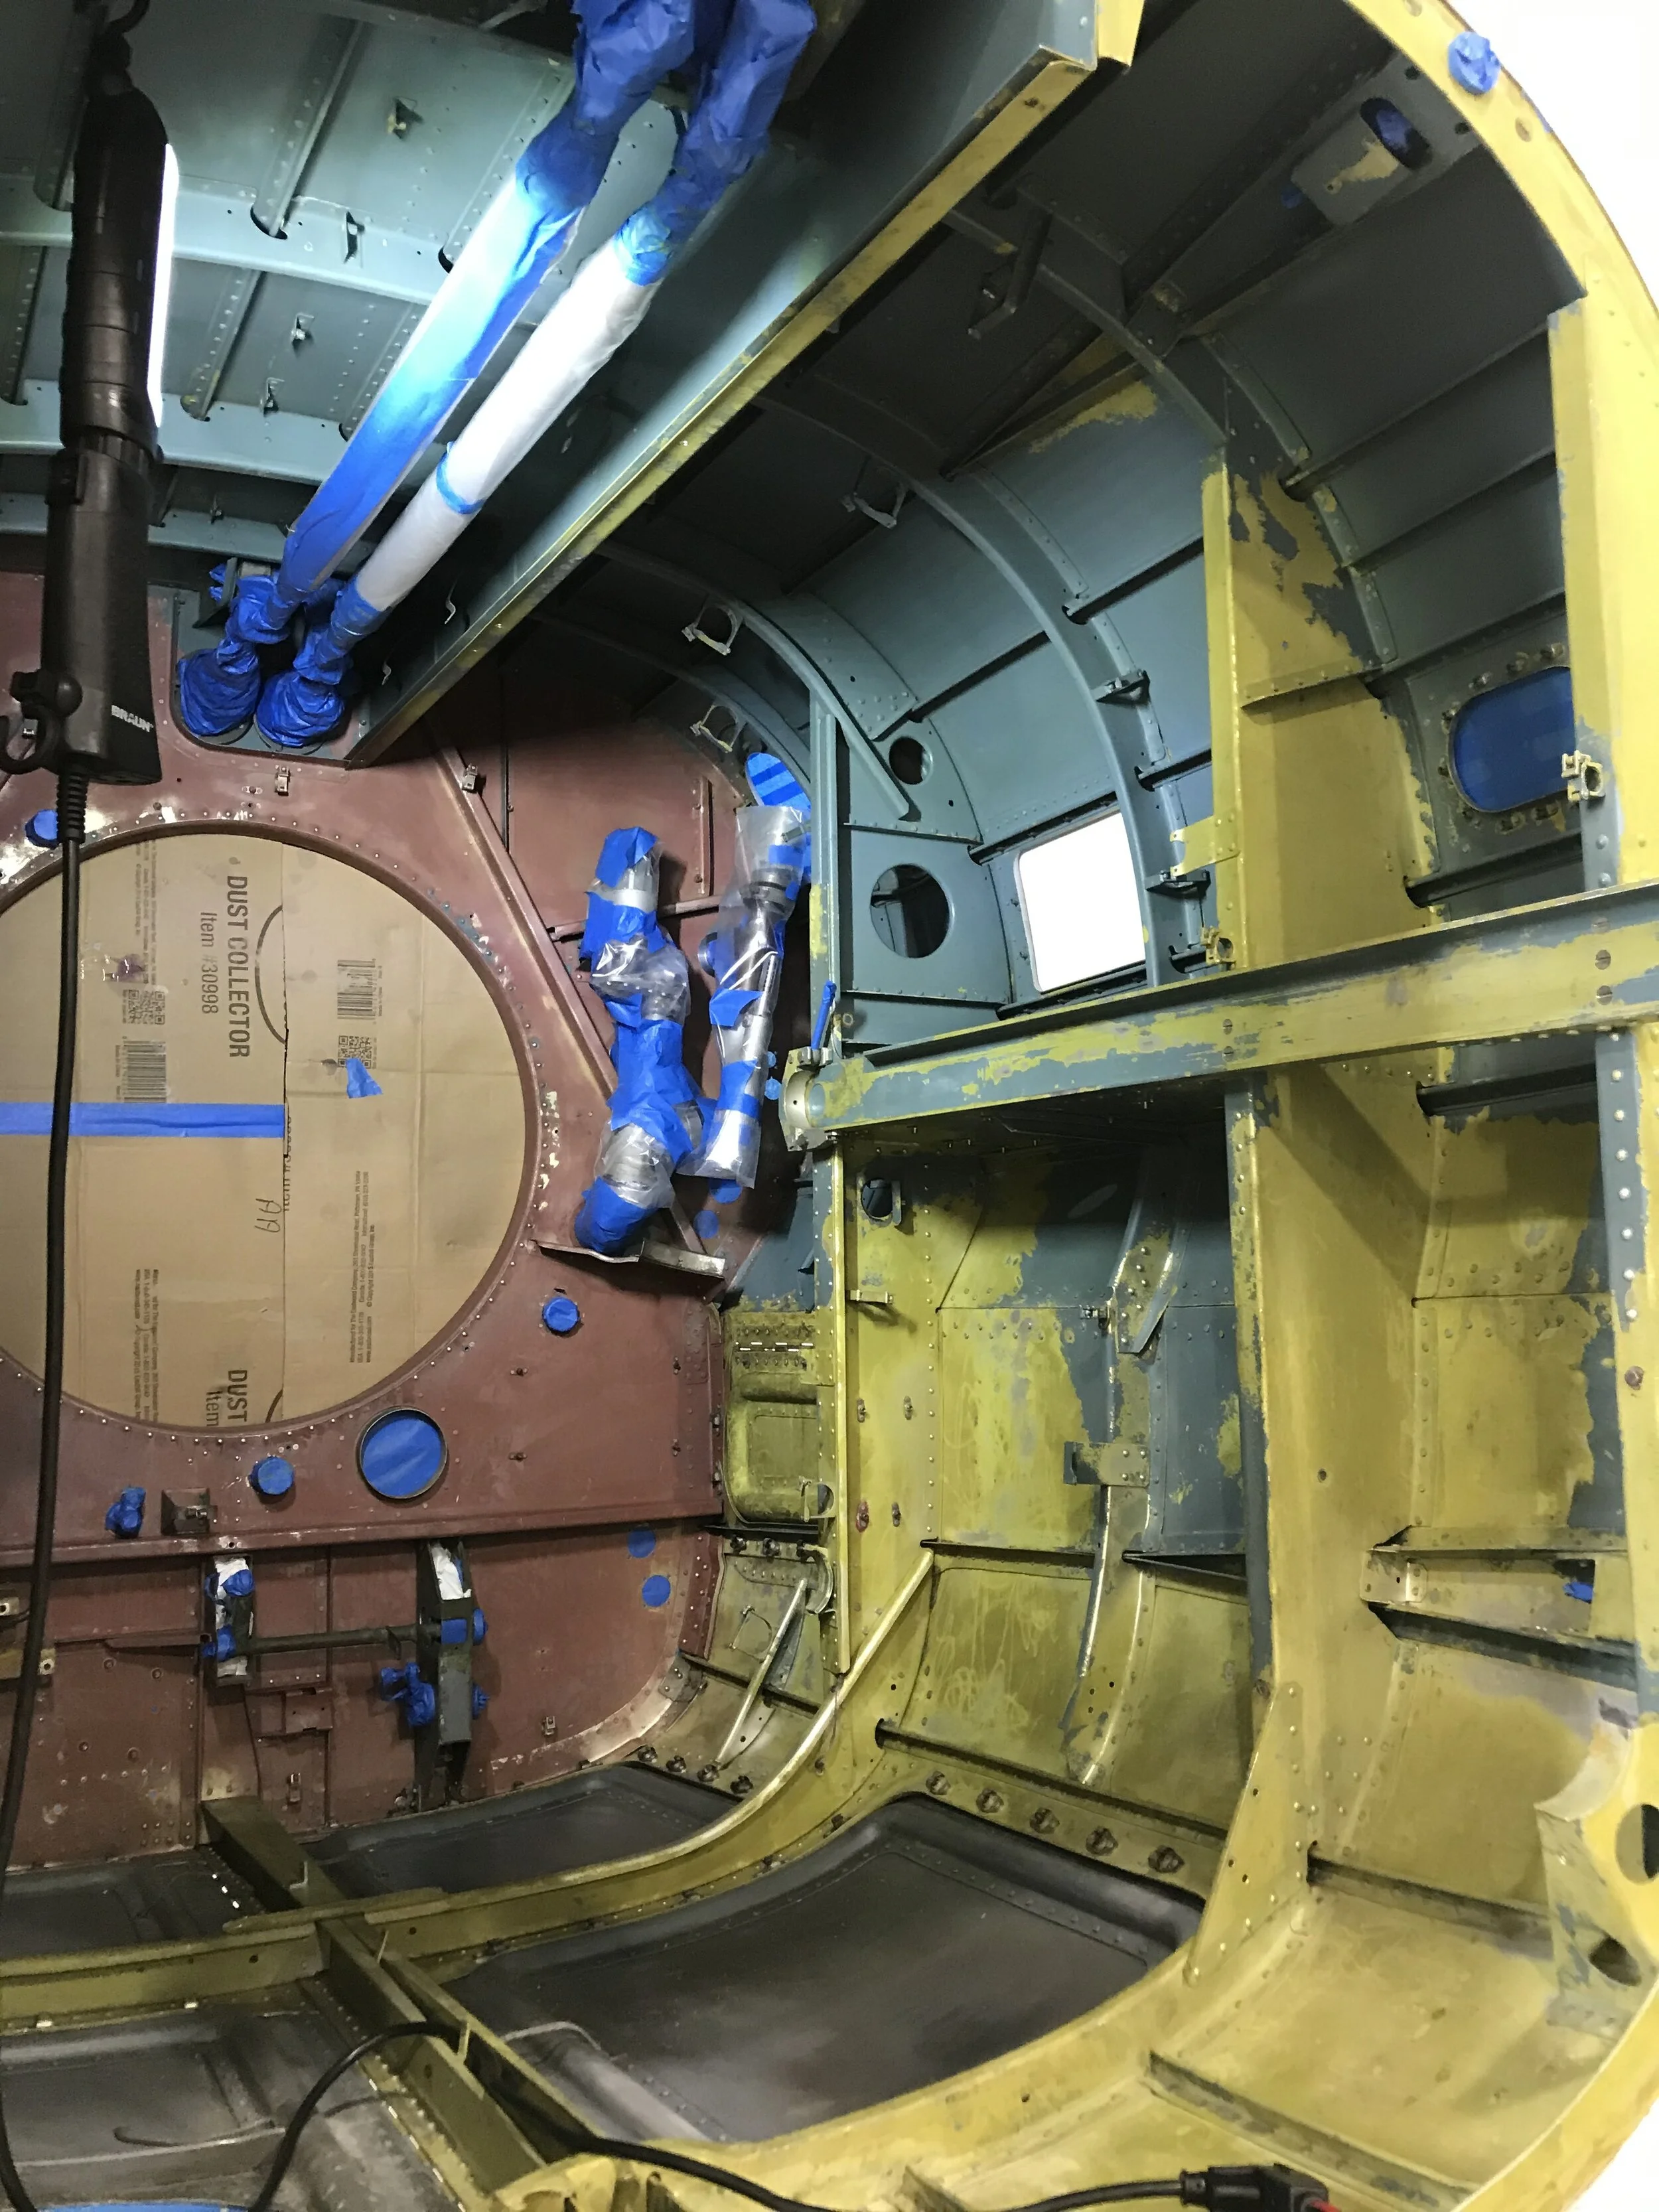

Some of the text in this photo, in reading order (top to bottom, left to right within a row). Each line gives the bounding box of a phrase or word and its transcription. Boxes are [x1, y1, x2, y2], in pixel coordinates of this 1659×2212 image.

[111, 705, 151, 732] BRAUN
[200, 912, 218, 1013] Item #30998
[227, 876, 250, 1057] DUST COLLECTOR
[206, 1391, 223, 1426] Item
[227, 1370, 248, 1422] DUST
